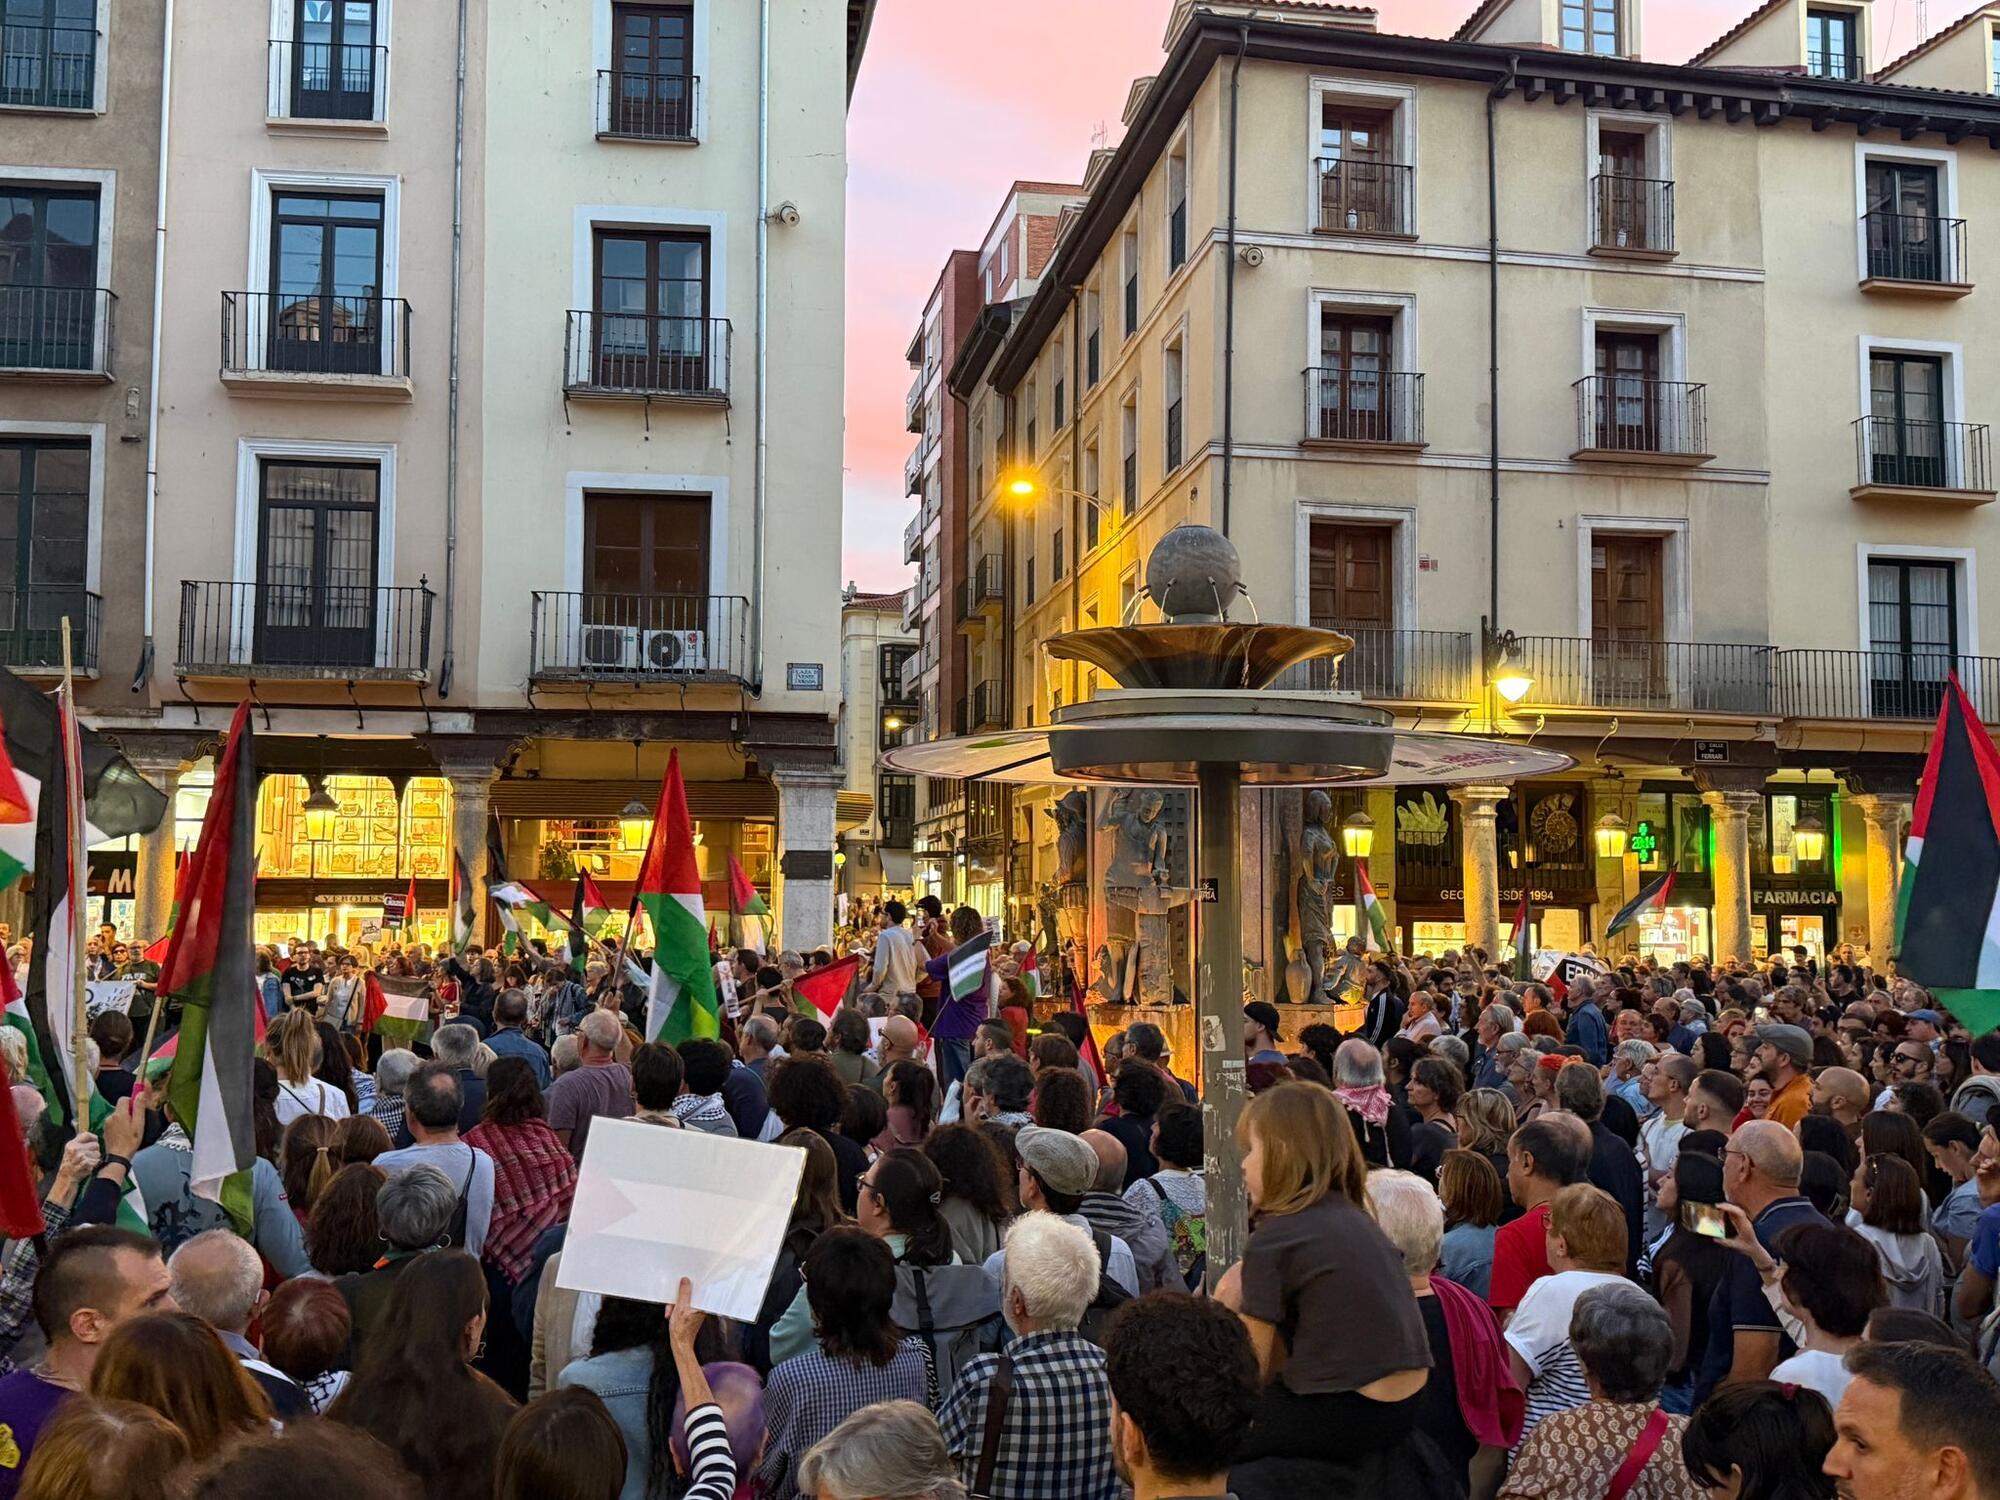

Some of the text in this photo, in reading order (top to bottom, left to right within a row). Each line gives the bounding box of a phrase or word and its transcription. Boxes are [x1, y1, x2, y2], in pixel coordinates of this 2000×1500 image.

[1498, 890, 1525, 901] ESDE
[1529, 890, 1554, 901] 1994
[1753, 890, 1838, 905] FARMACIA
